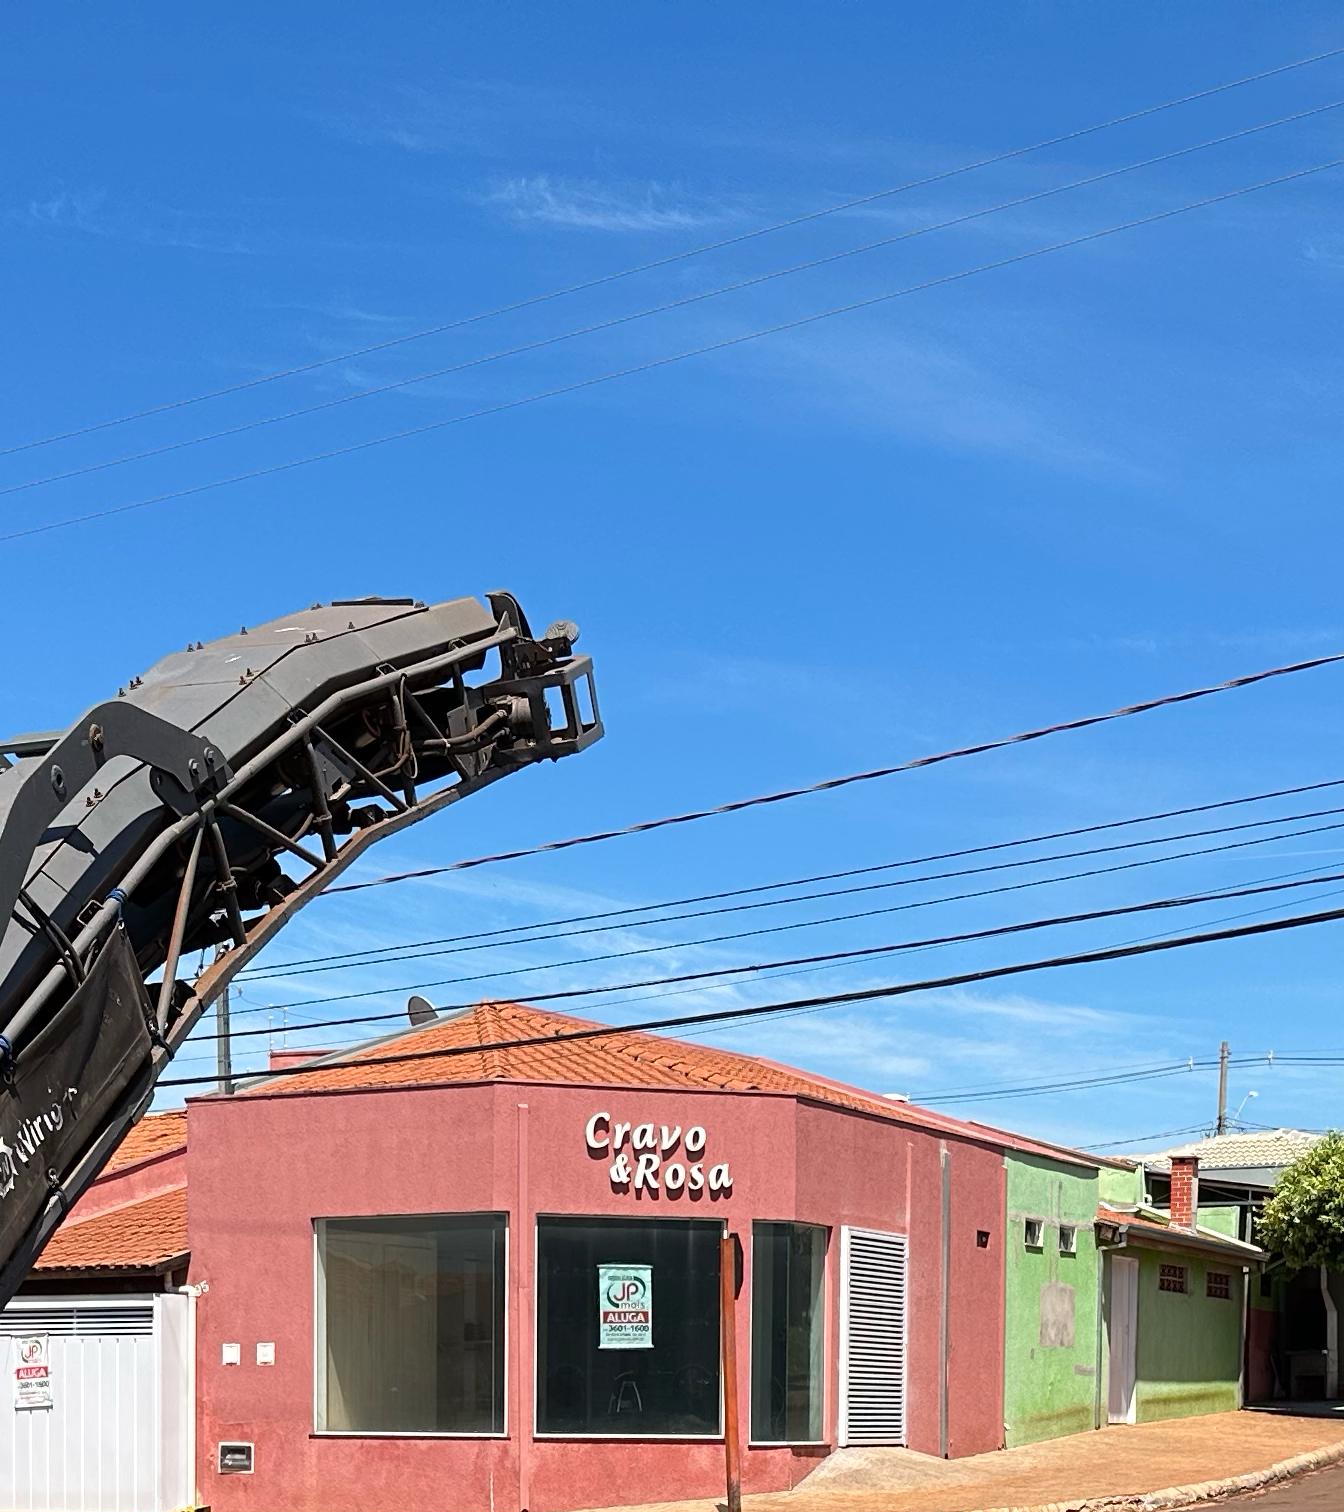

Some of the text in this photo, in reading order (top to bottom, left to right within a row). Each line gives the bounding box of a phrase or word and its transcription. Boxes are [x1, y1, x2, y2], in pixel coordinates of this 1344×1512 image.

[585, 1112, 707, 1151] Cravo
[606, 1312, 646, 1323] ALUGA
[18, 1367, 47, 1378] ALUGA
